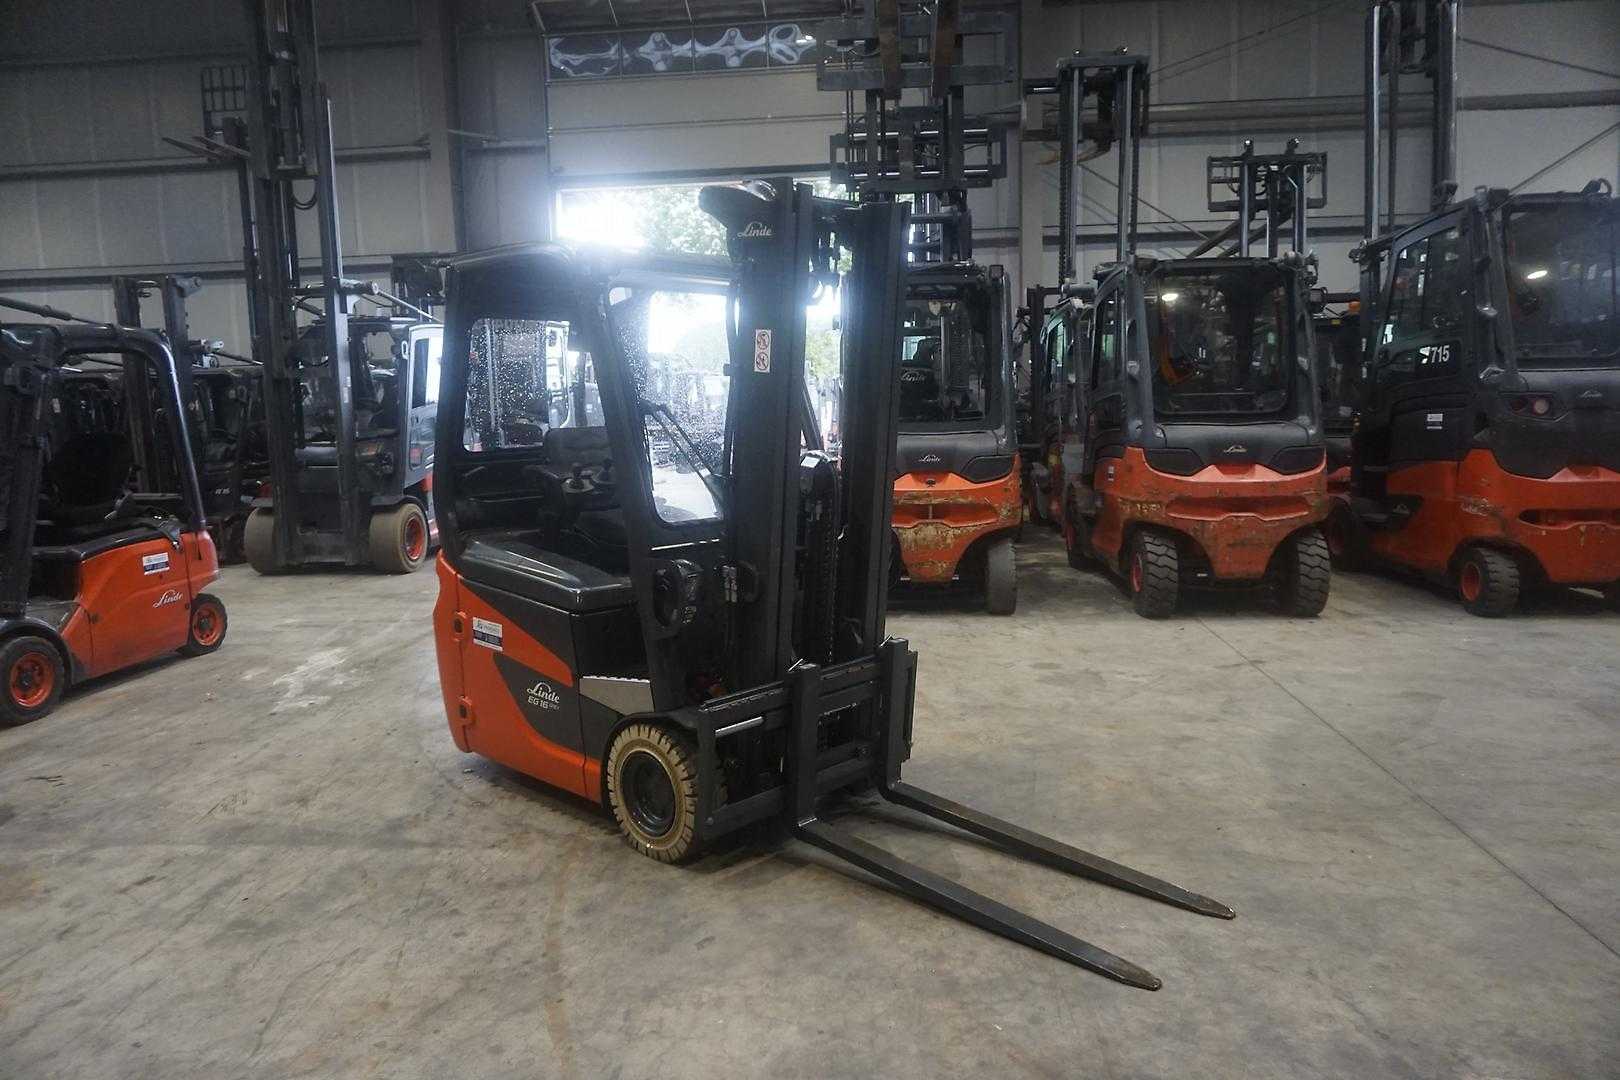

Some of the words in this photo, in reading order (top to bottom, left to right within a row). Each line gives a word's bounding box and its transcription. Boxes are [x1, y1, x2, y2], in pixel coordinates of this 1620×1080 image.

[737, 221, 772, 237] Linde
[1431, 345, 1450, 363] 715
[152, 589, 183, 608] Linde
[526, 682, 560, 703] Linde
